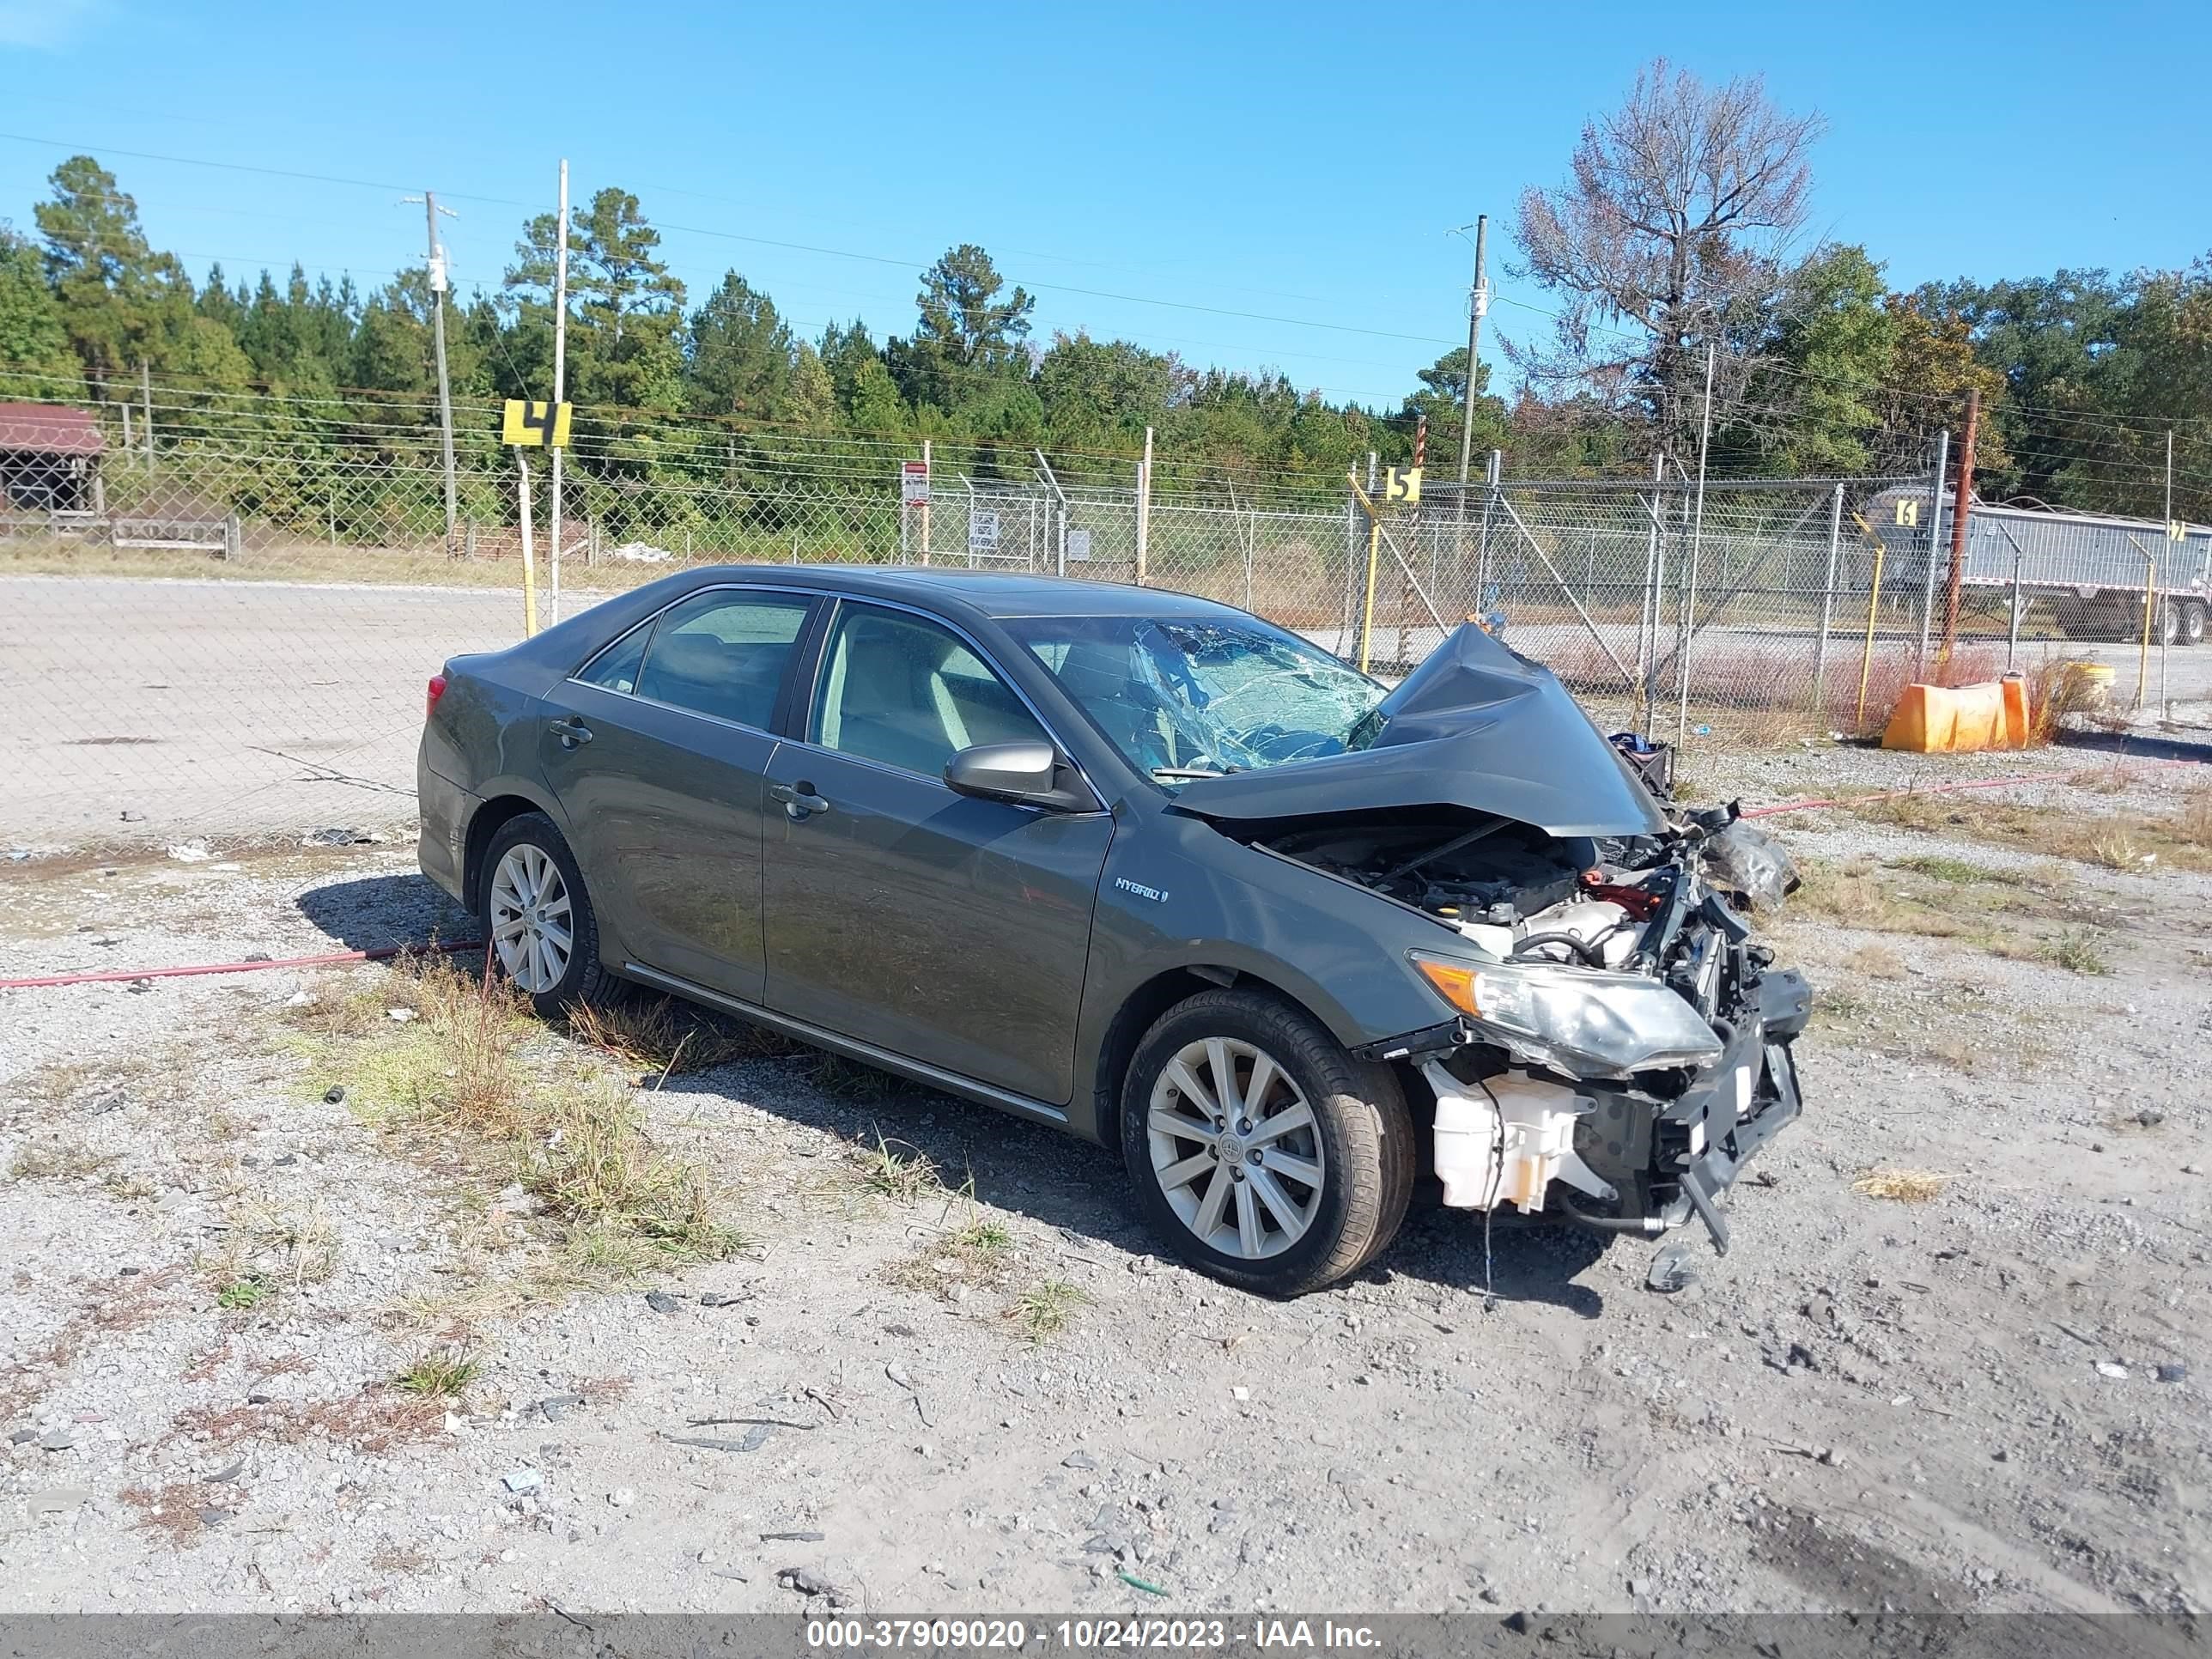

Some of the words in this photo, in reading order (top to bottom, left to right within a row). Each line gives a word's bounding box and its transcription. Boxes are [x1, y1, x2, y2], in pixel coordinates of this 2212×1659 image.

[523, 401, 558, 445] 4
[1391, 467, 1412, 501] 5
[1902, 501, 1912, 525] 6
[2174, 520, 2183, 541] 7
[1115, 877, 1159, 901] HYBRID
